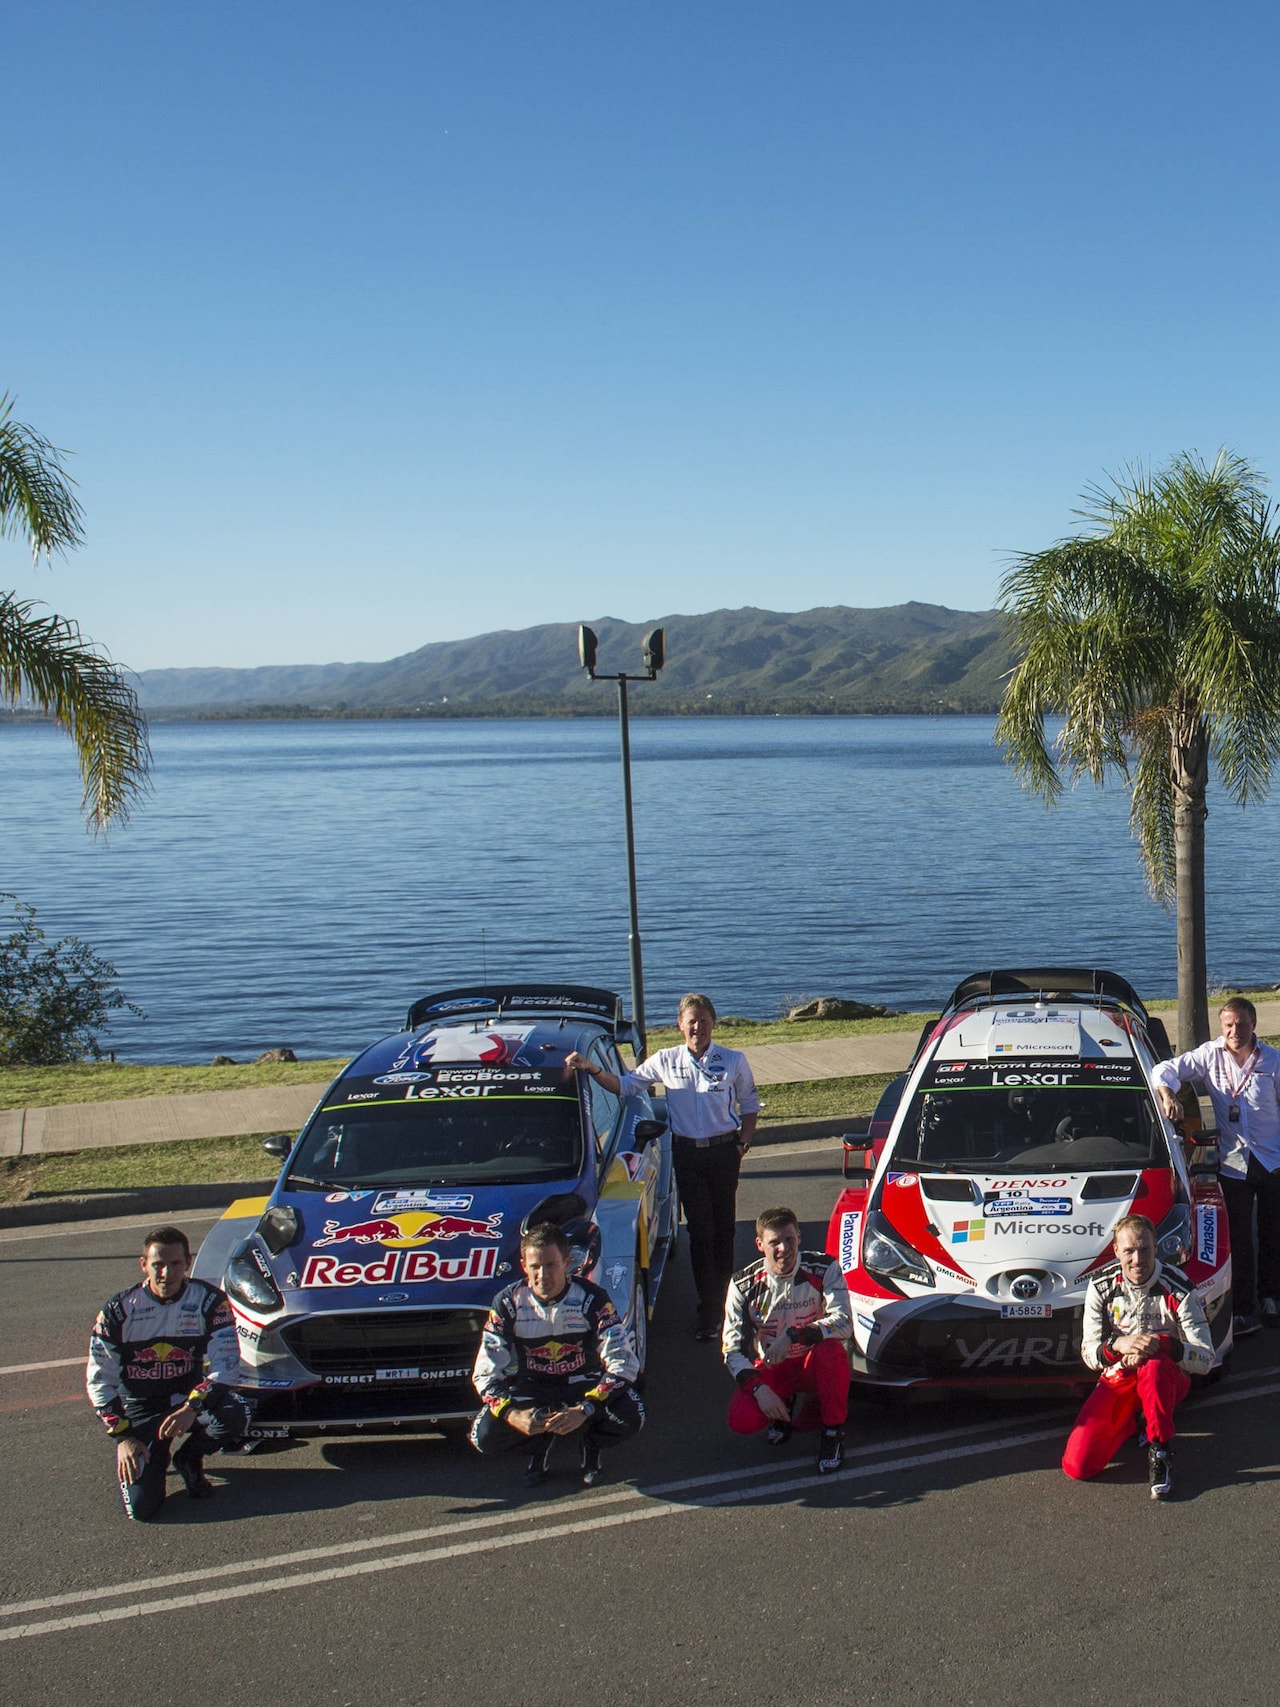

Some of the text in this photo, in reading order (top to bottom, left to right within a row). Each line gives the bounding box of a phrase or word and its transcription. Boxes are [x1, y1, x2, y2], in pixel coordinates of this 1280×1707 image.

[438, 998, 483, 1011] Ford
[510, 1000, 608, 1012] EcoBoost
[1016, 1043, 1074, 1051] Microsoft
[970, 1063, 1027, 1071] TOYOTA
[1084, 1063, 1132, 1072] Racing
[382, 1074, 421, 1085] Ford
[436, 1071, 543, 1083] EcoBoost
[934, 1076, 966, 1084] Lexar
[992, 1071, 1074, 1086] Lexar
[1100, 1074, 1132, 1082] Lexar
[405, 1084, 500, 1100] Lexar
[524, 1085, 557, 1093] Lexar
[347, 1092, 380, 1101] Lexar
[991, 1179, 1068, 1190] DENSO
[381, 1202, 429, 1210] Argentina
[990, 1205, 1034, 1213] Argentina
[993, 1221, 1106, 1237] Microsoft
[841, 1212, 860, 1272] Panasonic
[1199, 1208, 1216, 1264] Panasonic
[302, 1248, 499, 1287] Red Bull
[908, 1272, 929, 1284] PIAA
[936, 1265, 978, 1288] DMG MORI
[1008, 1306, 1043, 1316] A-5852
[555, 1352, 587, 1375] Bull
[324, 1374, 375, 1385] ONEBET
[420, 1367, 472, 1380] ONEBET
